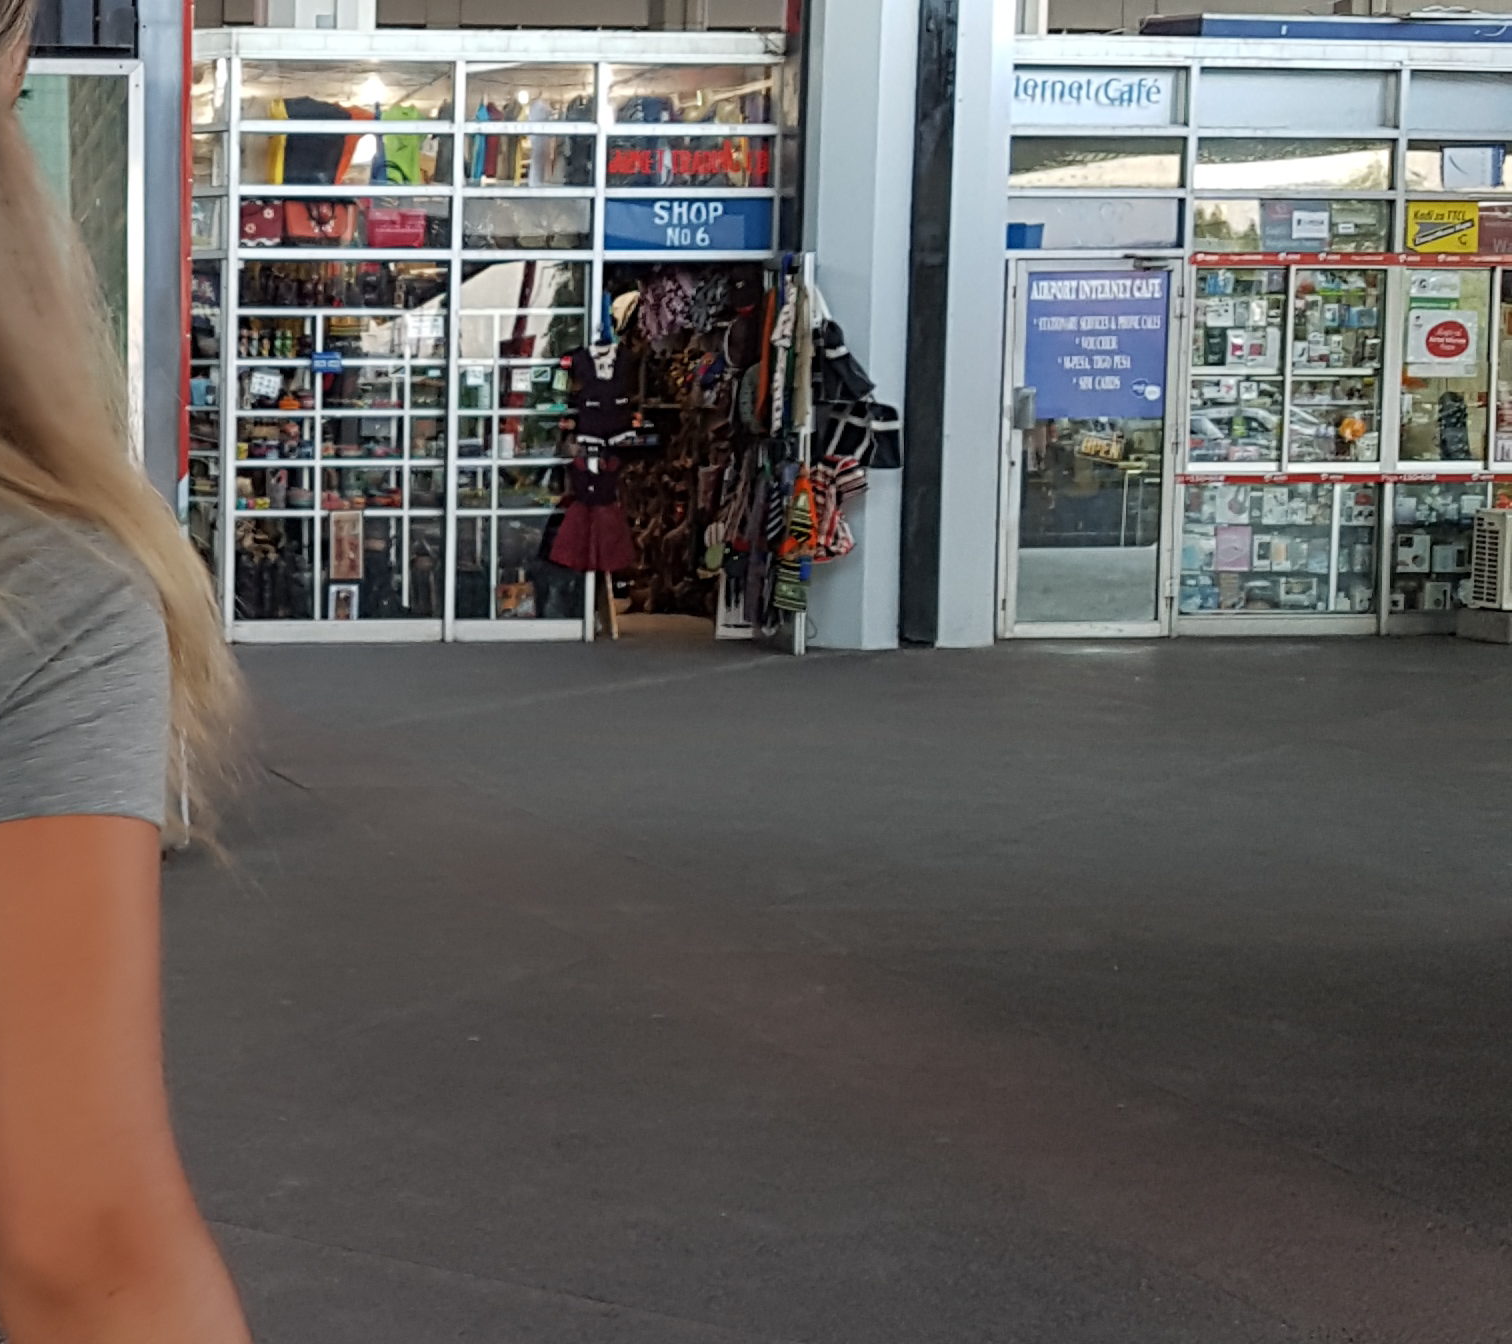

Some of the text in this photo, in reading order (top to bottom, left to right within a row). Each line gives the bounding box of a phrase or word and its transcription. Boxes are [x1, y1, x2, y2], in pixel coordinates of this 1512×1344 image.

[1099, 77, 1161, 106] Café
[653, 200, 723, 226] SHOP
[695, 227, 711, 247] 6
[1030, 278, 1162, 301] AIRPORT INTERNET CAFE
